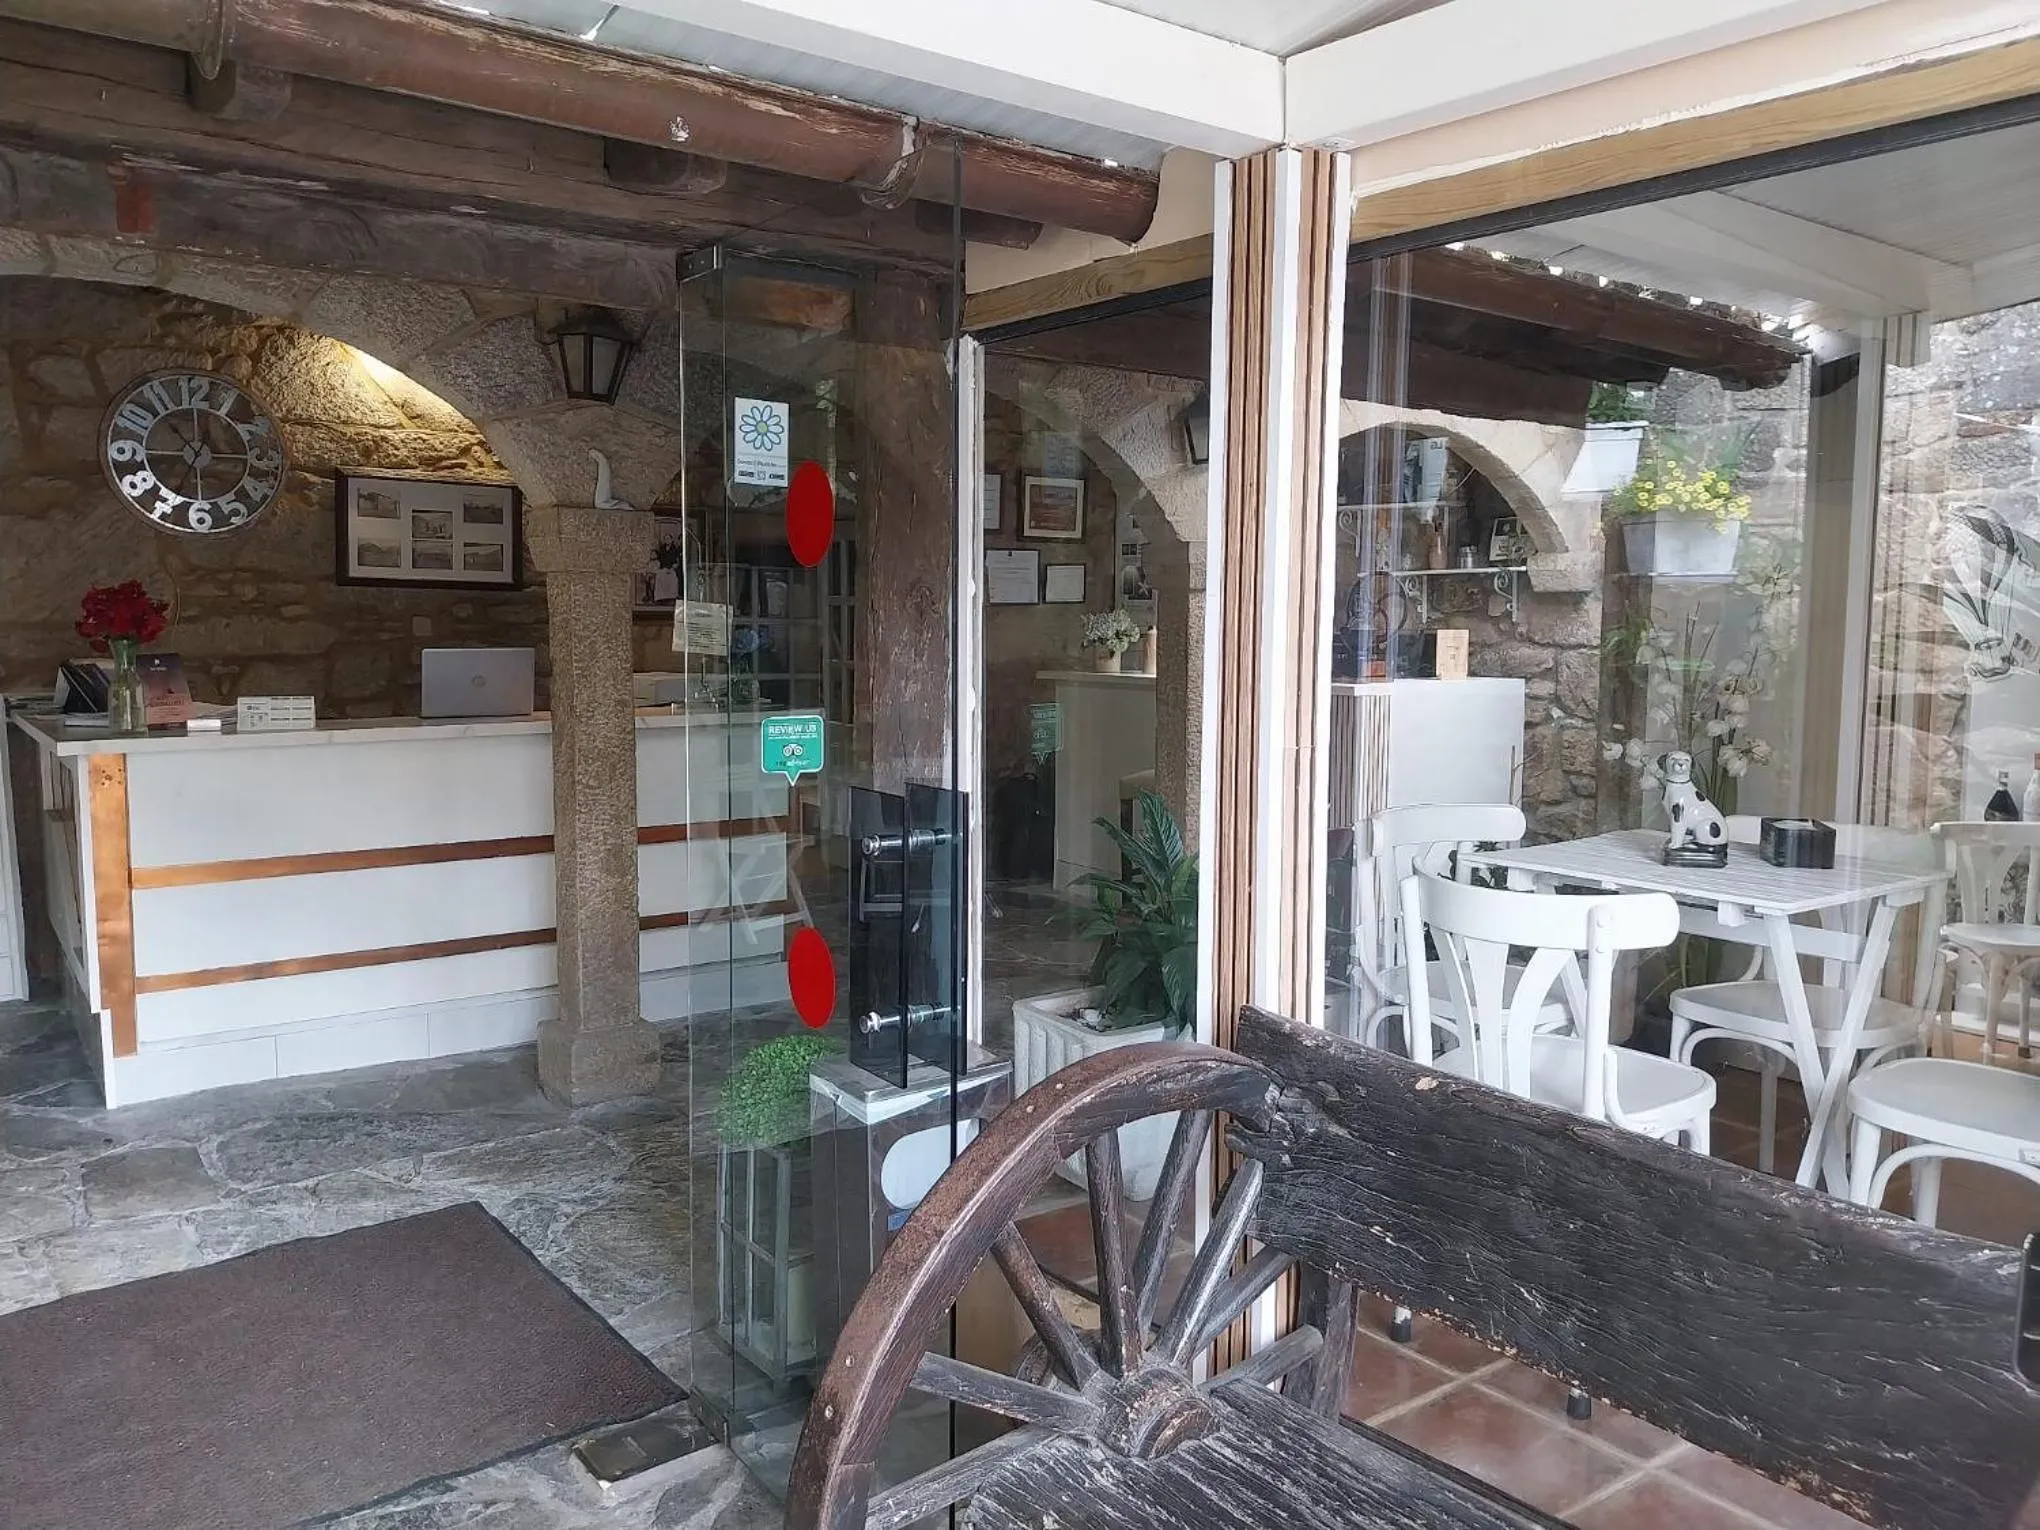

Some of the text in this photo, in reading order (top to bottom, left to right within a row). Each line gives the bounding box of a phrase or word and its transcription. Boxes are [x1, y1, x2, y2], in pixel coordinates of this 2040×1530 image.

[142, 380, 177, 415] 11
[178, 376, 210, 408] 12
[115, 402, 154, 437] 10
[109, 439, 145, 463] 9
[121, 470, 156, 498] 8
[150, 486, 185, 520] 7
[188, 501, 213, 532] 6
[217, 491, 248, 525] 5
[768, 724, 802, 734] REVIEW
